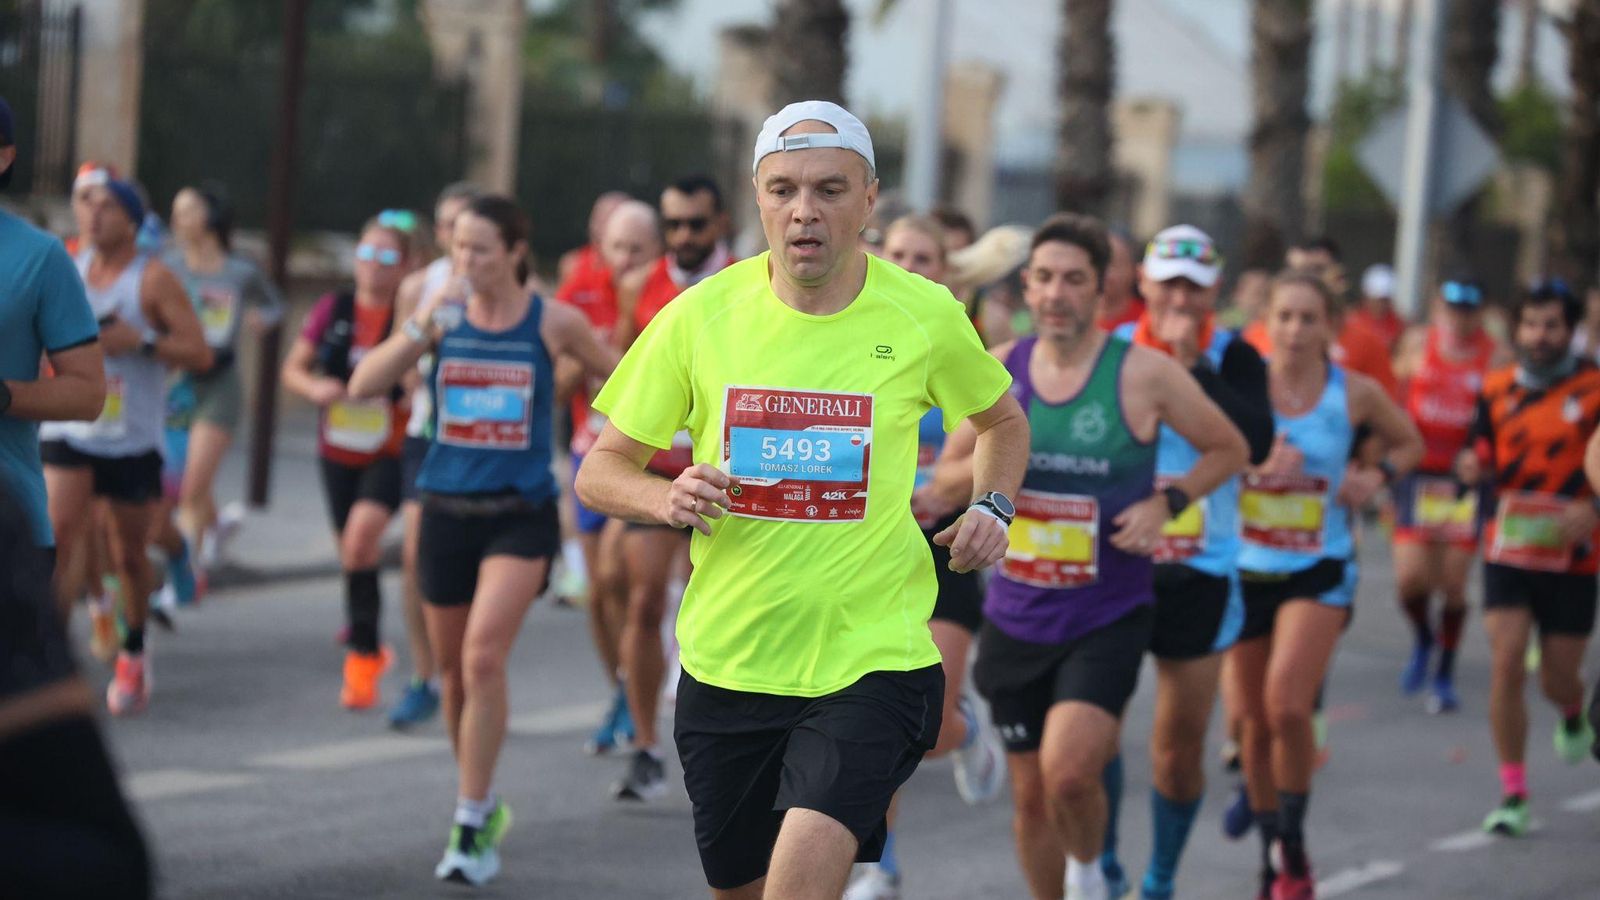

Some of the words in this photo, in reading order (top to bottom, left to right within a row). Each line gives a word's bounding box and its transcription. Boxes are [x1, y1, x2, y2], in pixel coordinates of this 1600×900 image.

[765, 396, 861, 417] GENERALI
[762, 437, 831, 461] 5493
[760, 462, 798, 472] TOMASZ
[802, 464, 832, 474] LOREK
[822, 492, 847, 500] 42K
